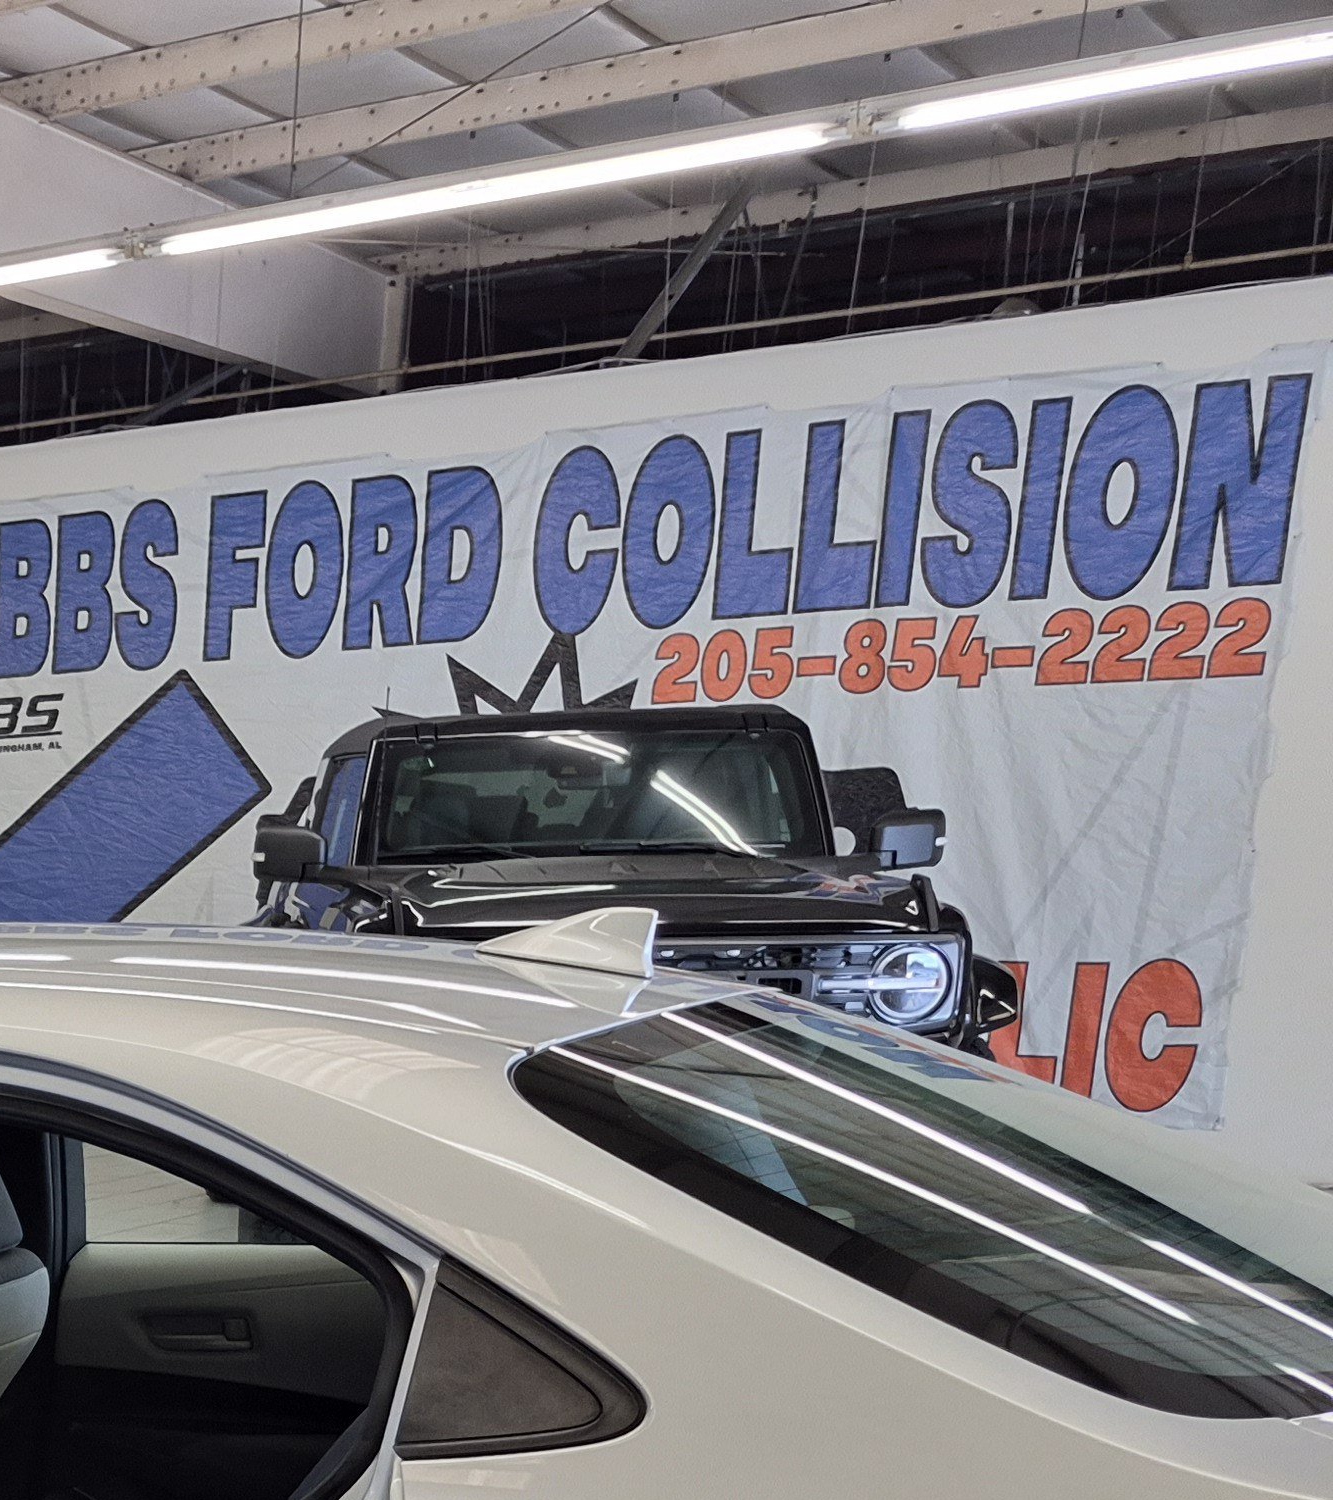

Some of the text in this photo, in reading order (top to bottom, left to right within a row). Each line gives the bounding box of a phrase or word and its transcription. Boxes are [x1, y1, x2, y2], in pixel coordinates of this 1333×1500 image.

[203, 466, 503, 661] FORD
[535, 373, 1311, 637] COLLISION
[652, 596, 1272, 706] 205-854-2222
[48, 741, 63, 751] AL
